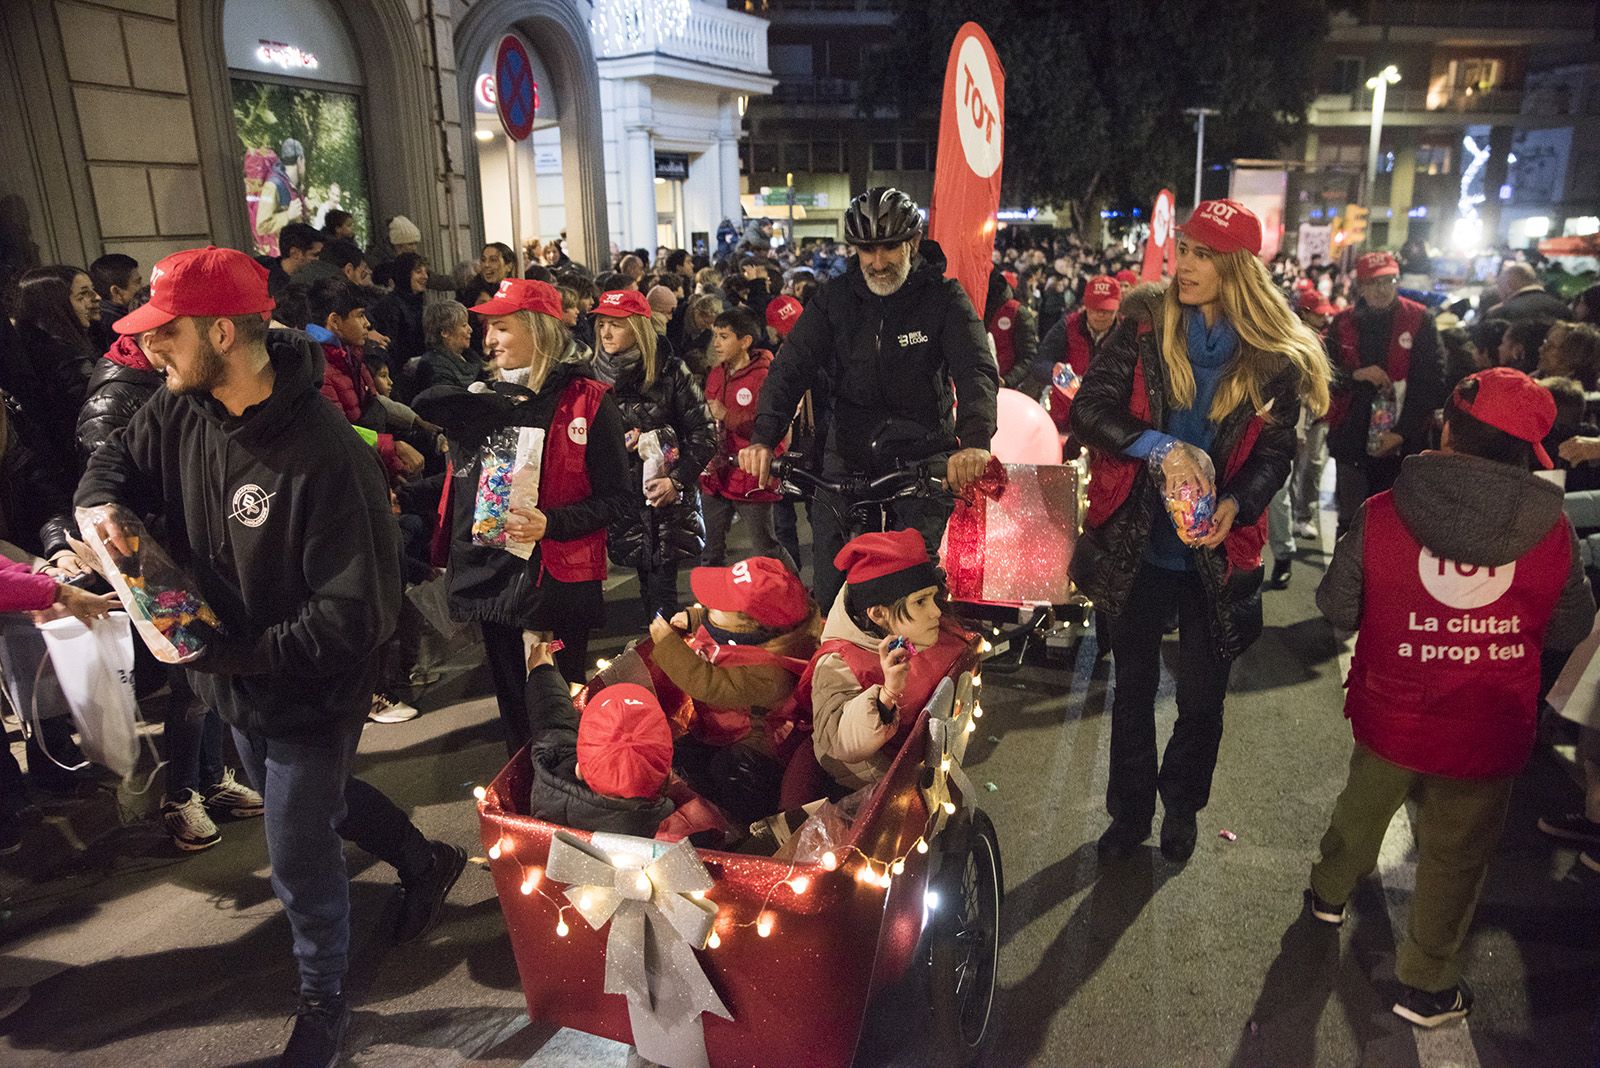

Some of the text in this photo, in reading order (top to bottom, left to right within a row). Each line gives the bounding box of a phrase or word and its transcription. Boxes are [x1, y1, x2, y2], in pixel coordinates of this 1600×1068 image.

[964, 63, 996, 144] TOT
[1204, 201, 1238, 220] TOT
[1094, 282, 1111, 291] TOT
[777, 303, 793, 316] TOT
[571, 427, 588, 435] TO
[731, 560, 752, 584] OT
[1408, 611, 1521, 635] La ciutat
[1398, 642, 1525, 664] a prop teu
